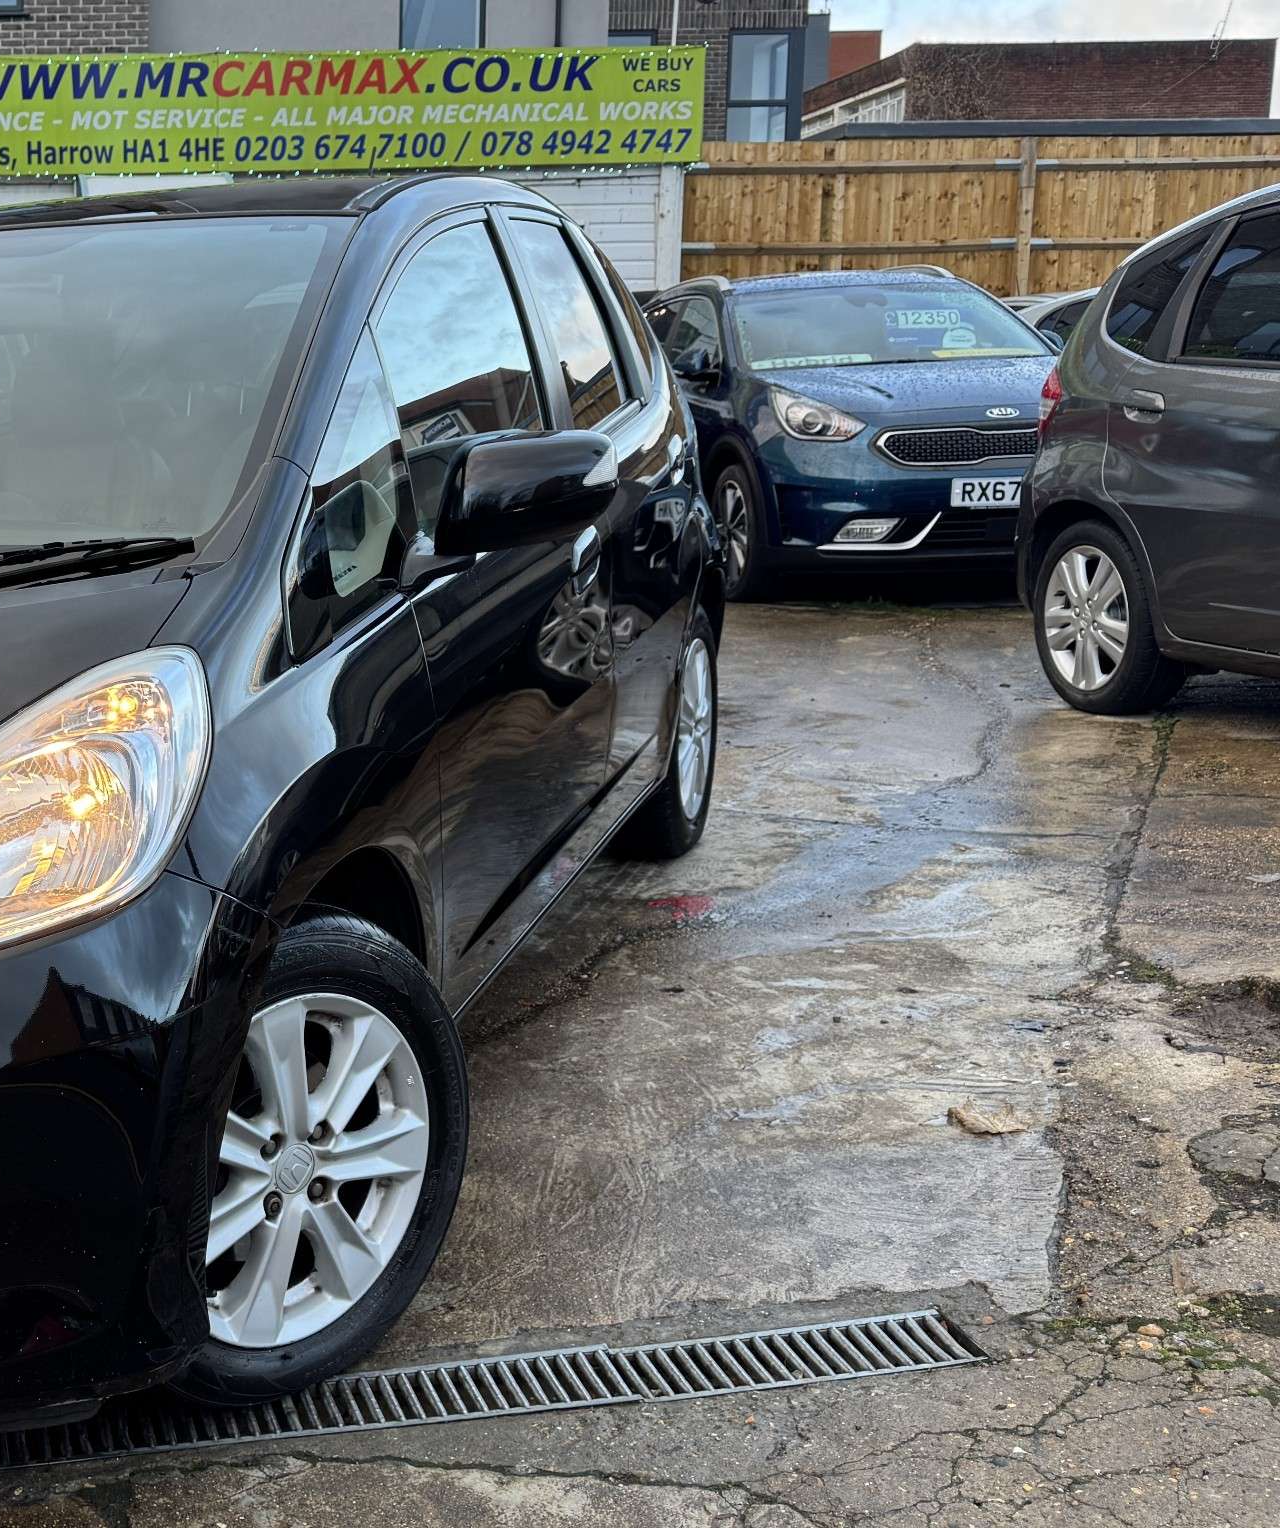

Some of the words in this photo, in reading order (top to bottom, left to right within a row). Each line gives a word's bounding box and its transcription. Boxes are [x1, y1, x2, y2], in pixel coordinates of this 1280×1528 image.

[623, 58, 649, 71] WE
[657, 58, 693, 71] BUY
[633, 79, 680, 92] CARS
[72, 111, 128, 129] MOT
[135, 109, 245, 128] SERVICE
[272, 108, 316, 126] ALL
[327, 106, 414, 125] MAJOR
[422, 103, 587, 123] MECHANICAL
[600, 102, 692, 120] WORKS
[27, 141, 113, 165] Harrow
[124, 139, 169, 163] HA1
[179, 138, 224, 162] 4HE
[235, 135, 304, 161] 0203
[315, 135, 365, 160] 674
[377, 133, 445, 158] 7100
[482, 131, 533, 156] 078
[542, 130, 611, 155] 4942
[621, 129, 692, 153] 4747
[885, 310, 960, 327] £12350
[962, 481, 1021, 502] RX67
